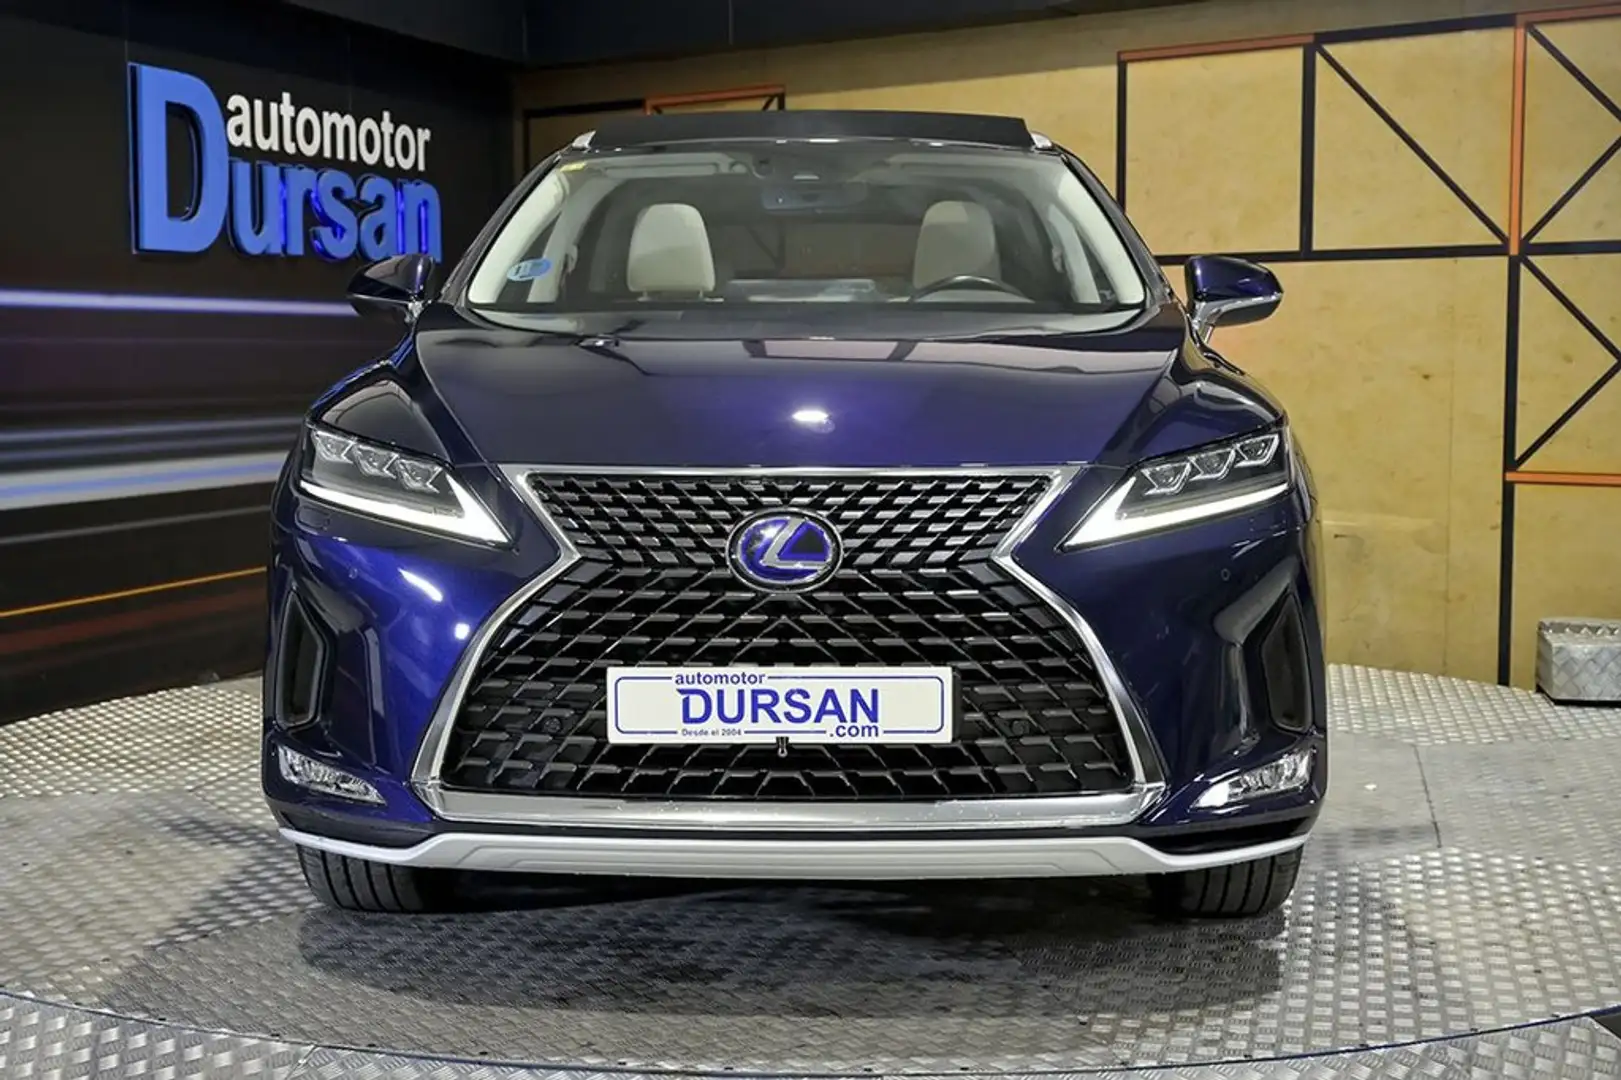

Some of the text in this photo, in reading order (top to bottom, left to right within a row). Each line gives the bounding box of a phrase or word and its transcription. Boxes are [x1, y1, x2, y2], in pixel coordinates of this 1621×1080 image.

[226, 92, 431, 171] automotor
[128, 62, 442, 263] Dursan
[675, 672, 766, 685] automotor
[676, 688, 879, 724] DURSAN
[681, 729, 709, 737] Desde
[721, 729, 742, 737] 2004
[829, 725, 879, 738] .com
